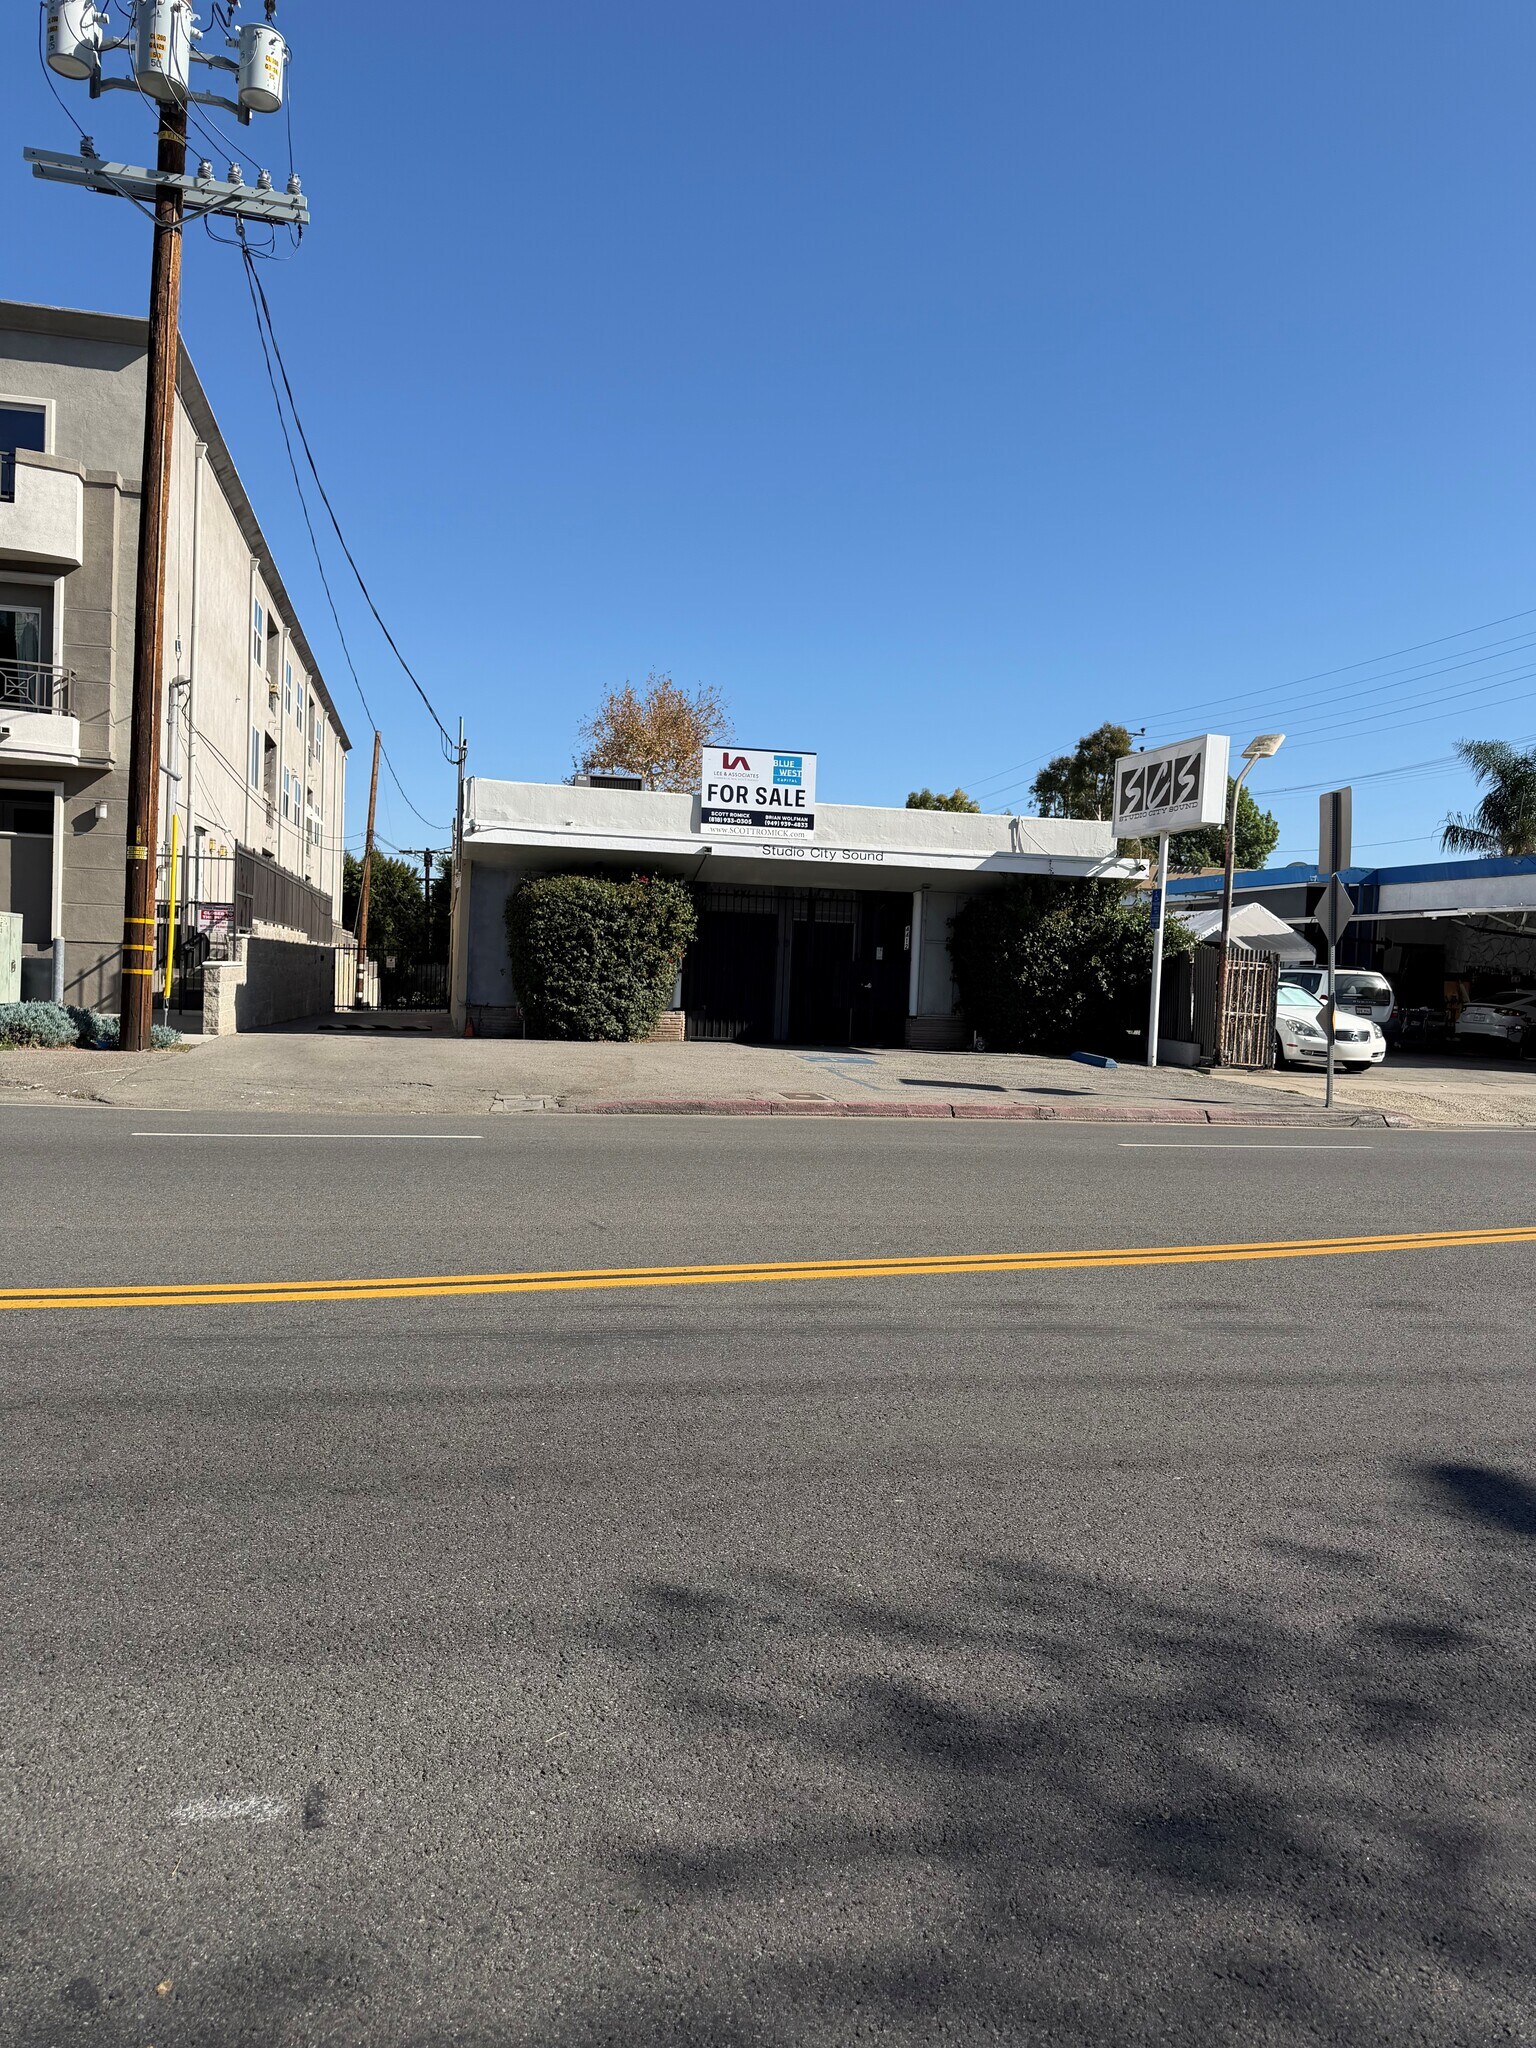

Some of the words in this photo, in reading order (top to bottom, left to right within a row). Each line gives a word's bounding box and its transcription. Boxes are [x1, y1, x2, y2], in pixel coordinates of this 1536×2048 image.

[779, 769, 802, 777] WEST
[708, 784, 748, 804] FOR
[755, 786, 806, 808] SALE
[1118, 812, 1147, 822] STUDIO
[1148, 808, 1168, 816] CITY
[1168, 801, 1199, 812] SOUND
[710, 827, 805, 838] www.SCOTTROMICK.com
[762, 844, 804, 858] Studio
[810, 847, 837, 862] City
[842, 849, 884, 862] Sound
